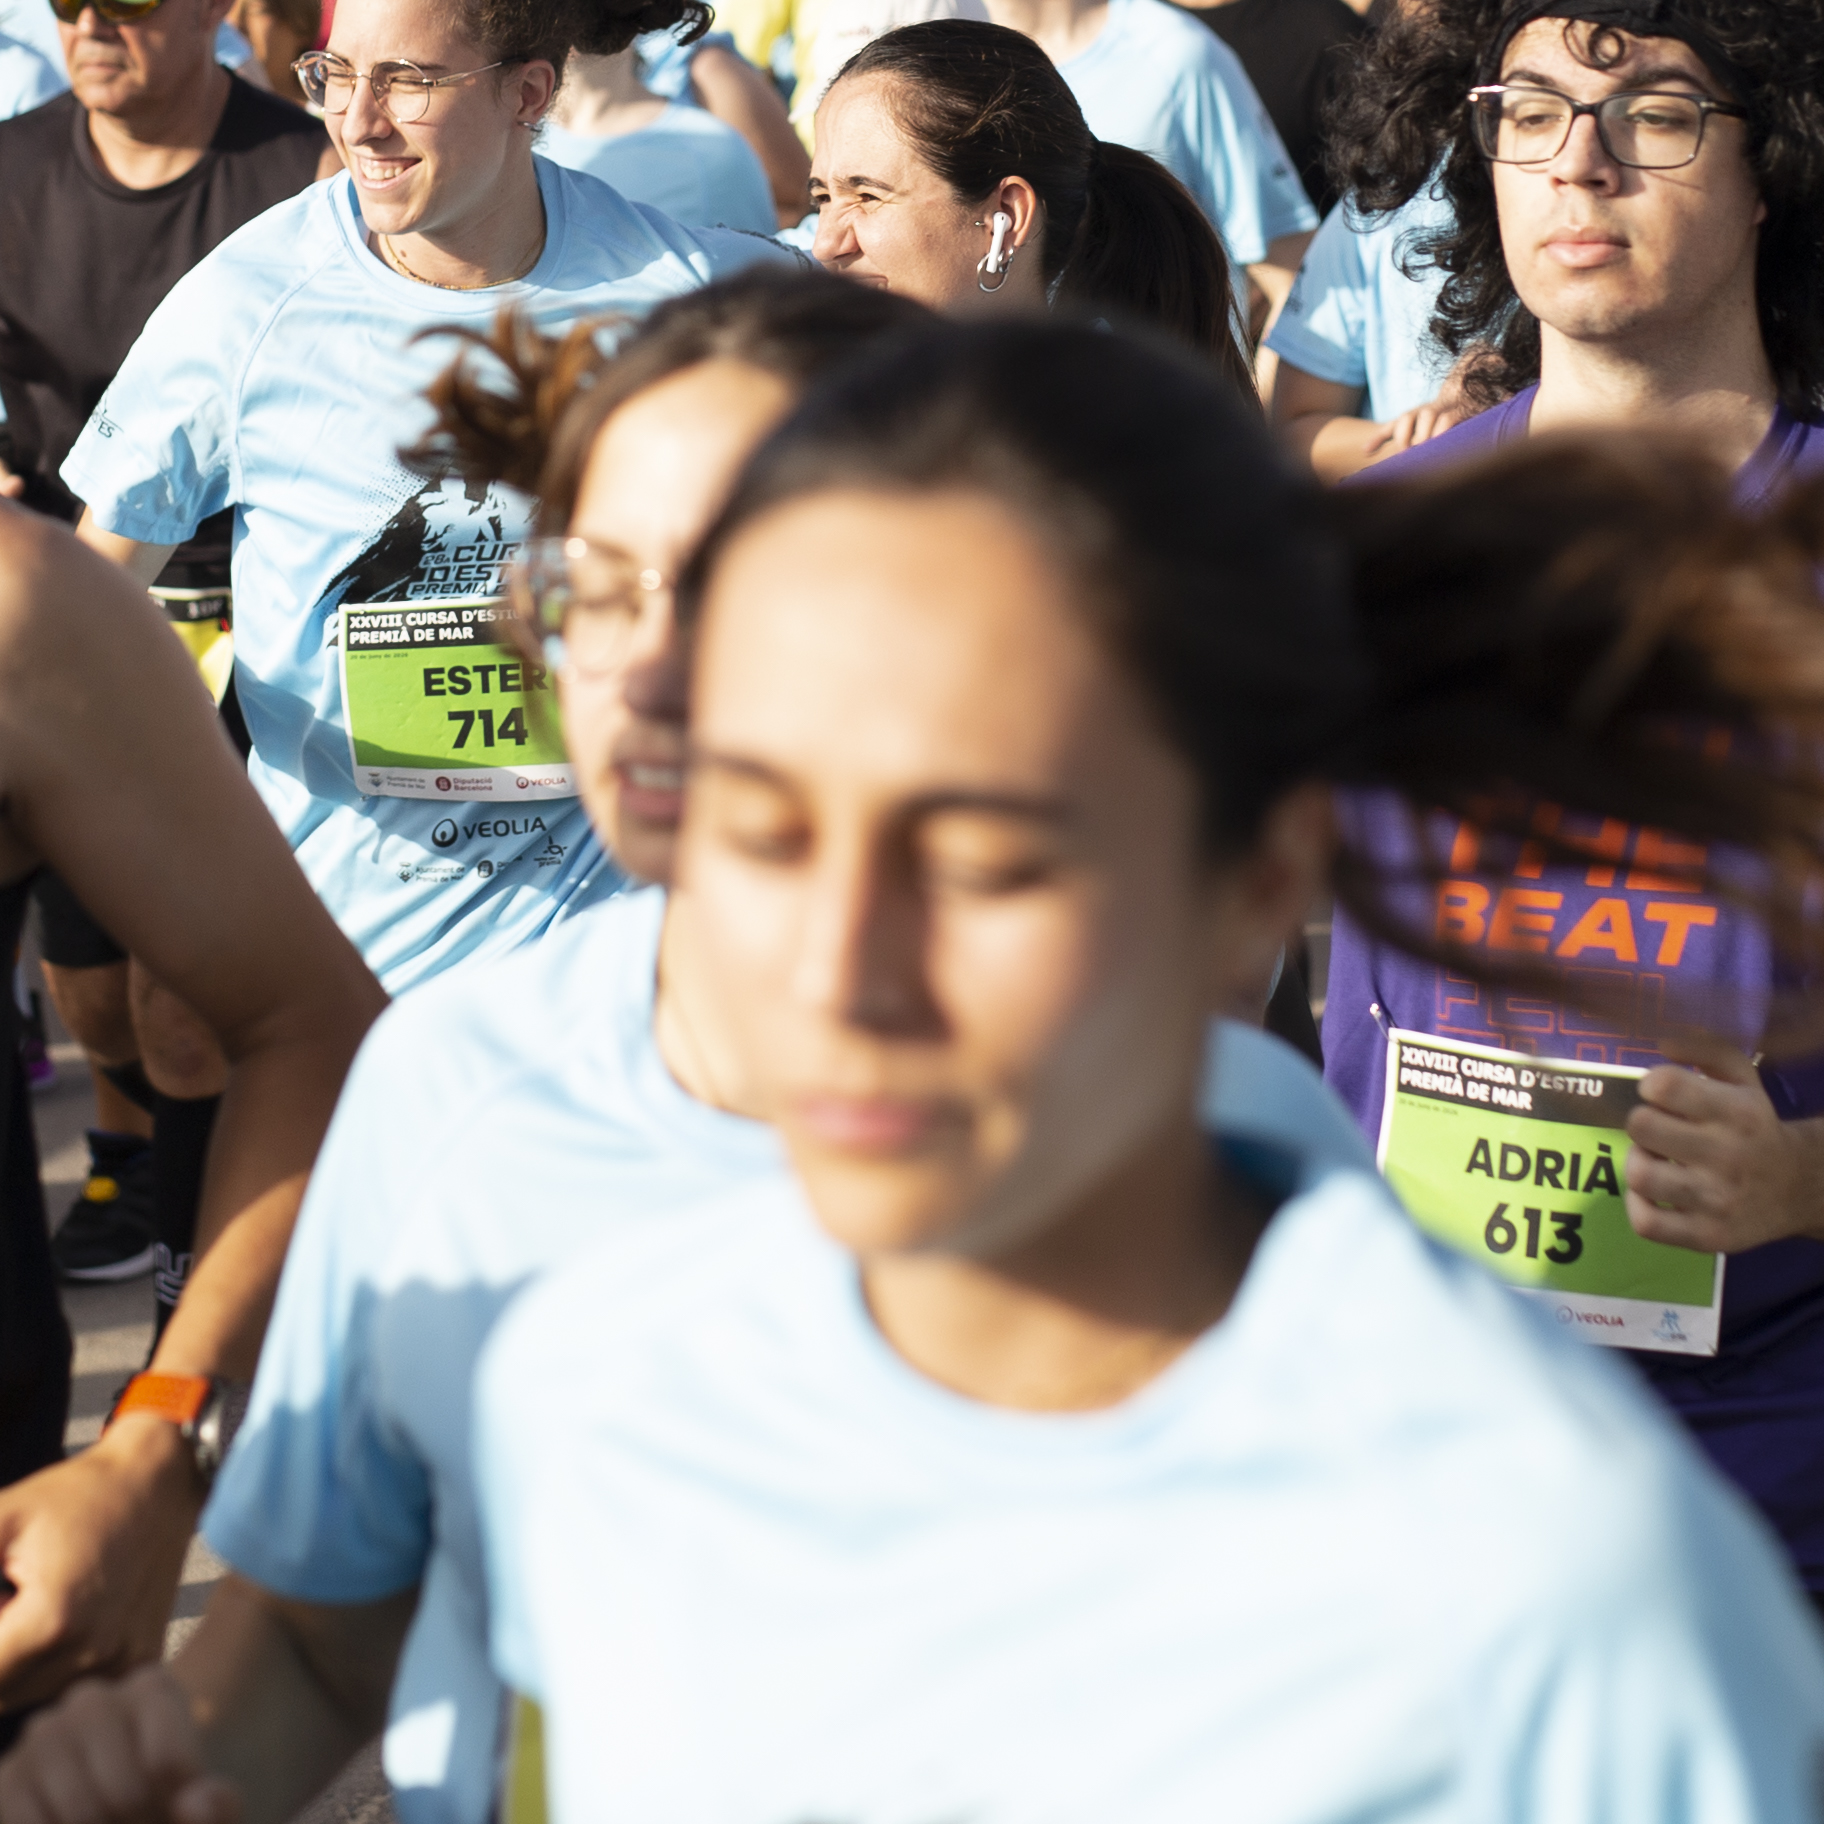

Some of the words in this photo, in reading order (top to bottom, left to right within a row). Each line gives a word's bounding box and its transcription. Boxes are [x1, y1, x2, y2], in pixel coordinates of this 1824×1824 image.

[452, 542, 522, 563] CUR
[426, 563, 514, 583] D'EST
[349, 612, 404, 629] XXVIII
[406, 609, 458, 627] CURSA
[349, 626, 411, 645] PREMIÀ
[414, 627, 435, 642] DE
[438, 626, 474, 640] MAR
[423, 662, 549, 696] ESTER
[447, 707, 529, 750] 714
[530, 777, 567, 787] VEOLIA
[463, 816, 547, 840] VEOLIA
[1435, 879, 1718, 966] BEAT
[1401, 1045, 1459, 1075] XXVIII
[1460, 1057, 1516, 1087] CURSA
[1520, 1070, 1604, 1097] D'ESTIU
[1400, 1067, 1464, 1097] PREMIÀ
[1466, 1083, 1490, 1102] DE
[1491, 1088, 1533, 1111] MAR
[1465, 1136, 1620, 1196] ADRIÀ
[1484, 1202, 1583, 1265] 613
[1576, 1312, 1625, 1327] VEOLIA
